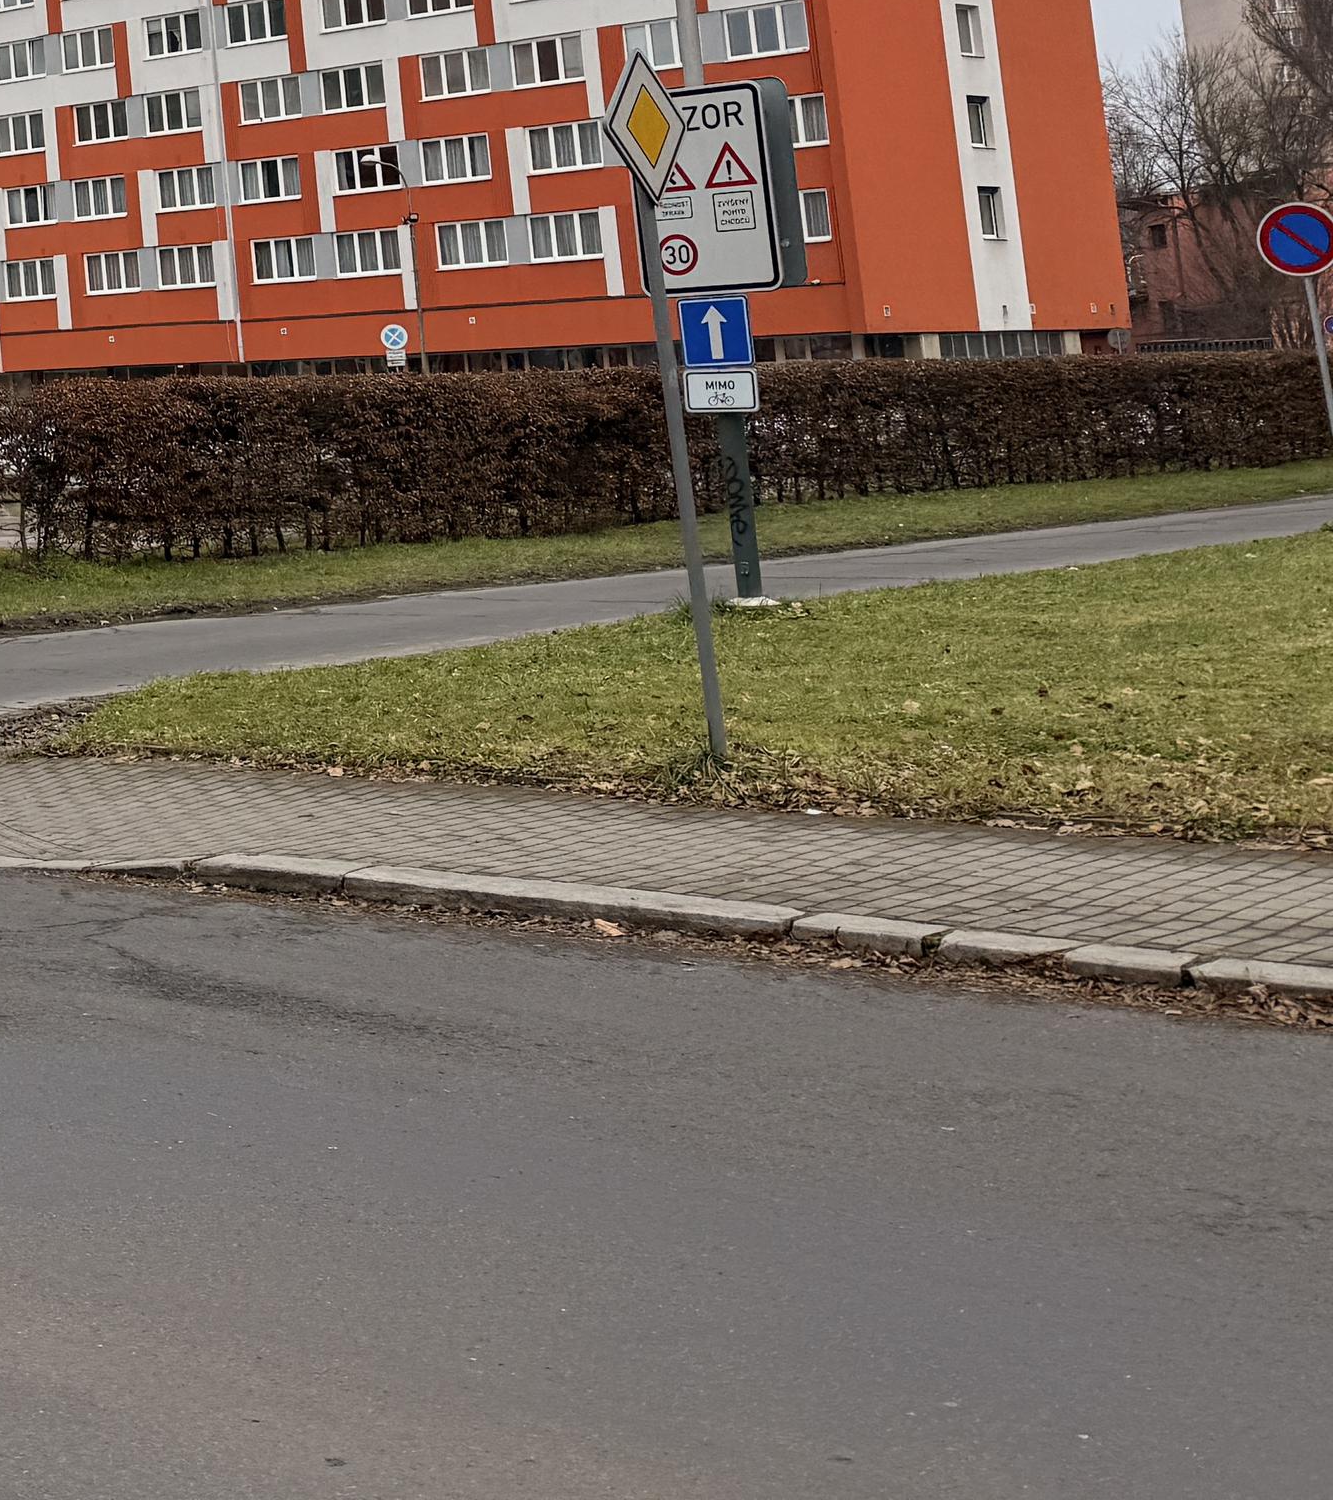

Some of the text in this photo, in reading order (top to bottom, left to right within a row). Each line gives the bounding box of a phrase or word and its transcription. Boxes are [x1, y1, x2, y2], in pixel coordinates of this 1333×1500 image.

[681, 100, 744, 132] ZOR
[664, 244, 690, 265] 30
[705, 380, 735, 391] MIMO
